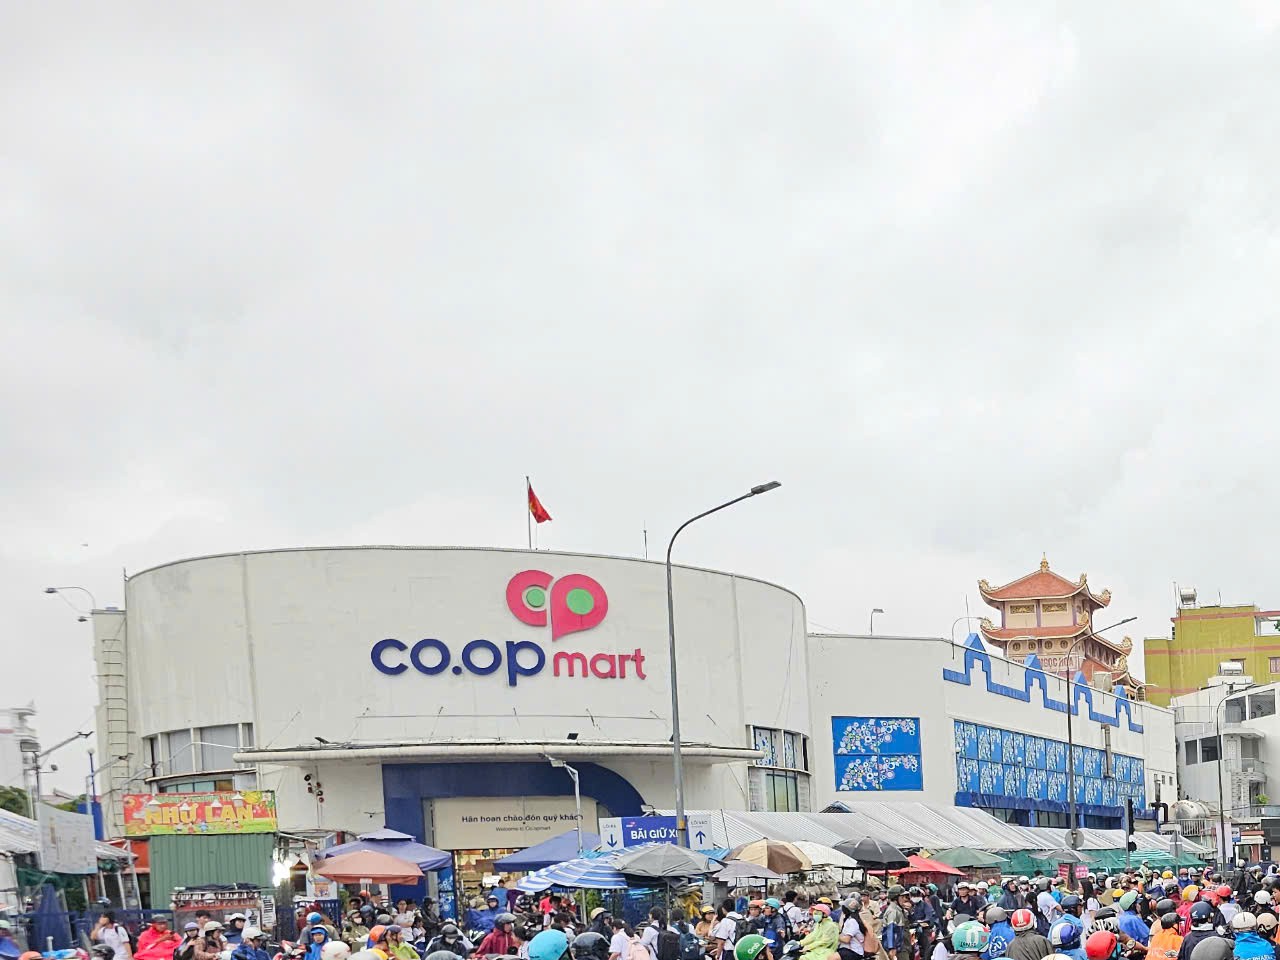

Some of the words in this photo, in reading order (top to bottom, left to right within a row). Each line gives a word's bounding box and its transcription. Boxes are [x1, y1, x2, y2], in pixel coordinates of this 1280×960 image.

[553, 648, 647, 680] mart
[631, 828, 647, 840] BÃI
[649, 827, 668, 839] GIỮ
